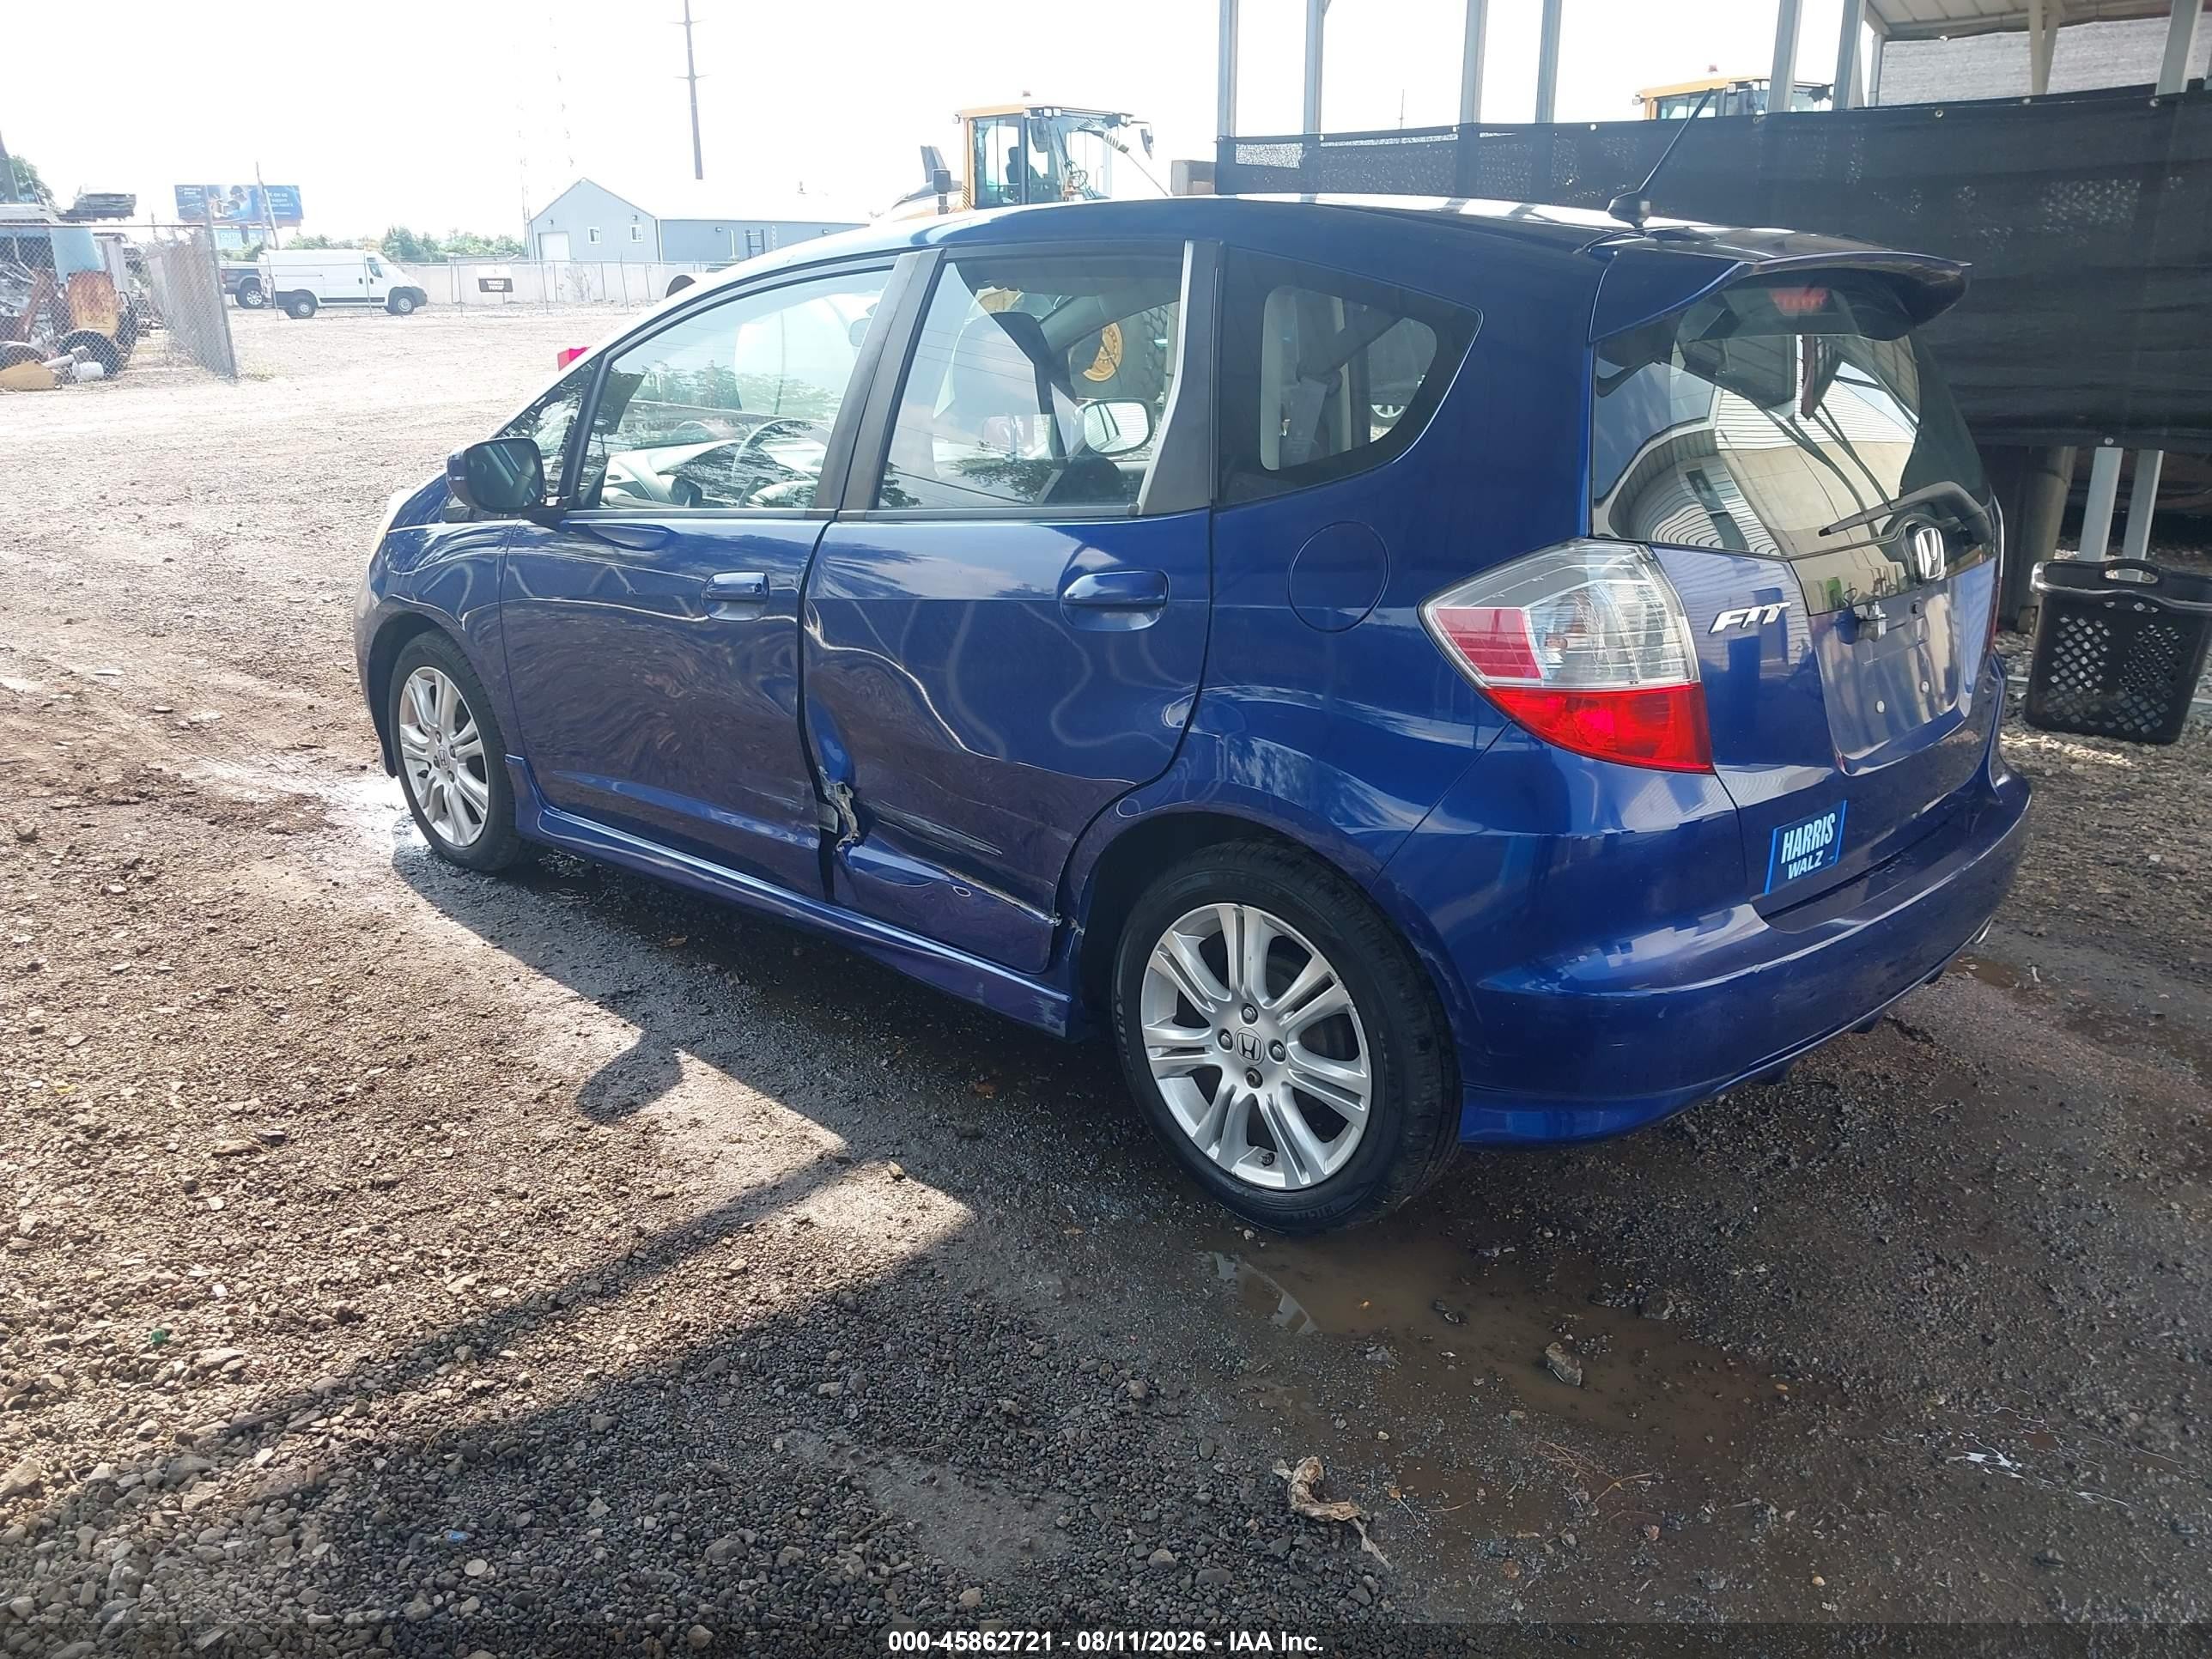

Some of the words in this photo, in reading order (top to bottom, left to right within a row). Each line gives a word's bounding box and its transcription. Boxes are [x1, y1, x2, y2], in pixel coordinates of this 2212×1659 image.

[1709, 601, 1792, 634] FIT
[1780, 812, 1836, 865] HARRIS
[1788, 849, 1825, 880] WALZ
